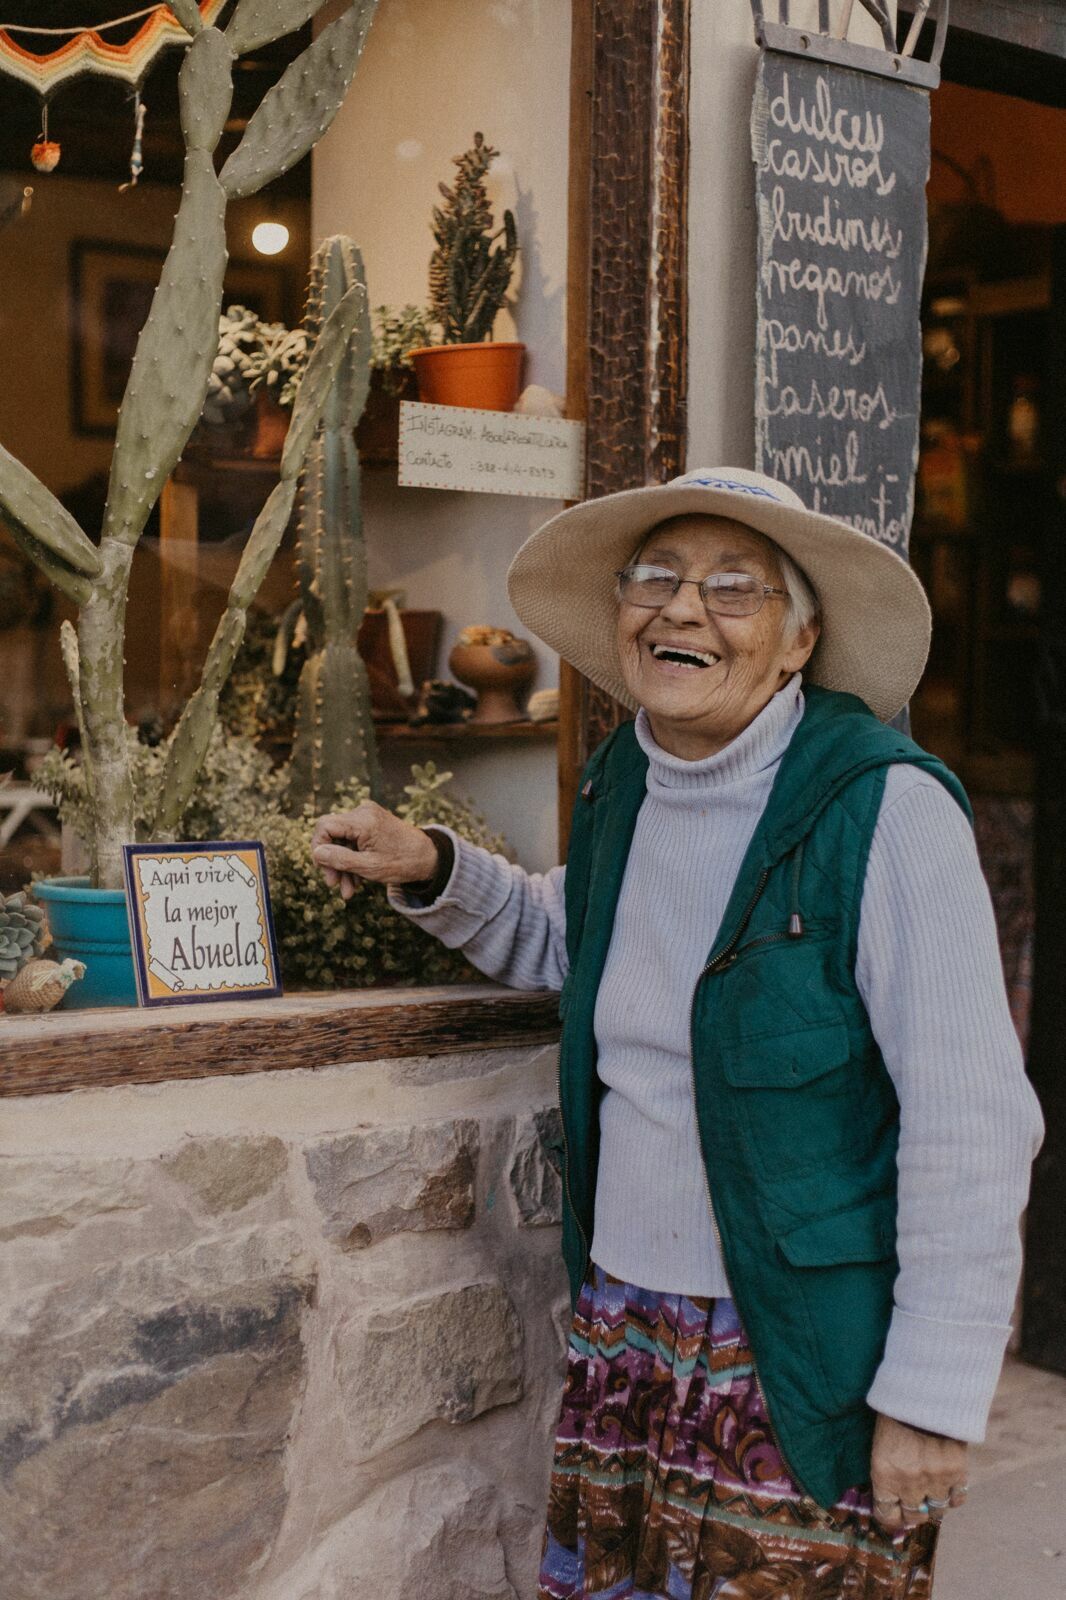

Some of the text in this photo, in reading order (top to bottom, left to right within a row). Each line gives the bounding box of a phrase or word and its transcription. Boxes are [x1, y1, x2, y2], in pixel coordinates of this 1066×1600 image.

[770, 71, 885, 152] dulces
[772, 186, 903, 259] budines
[766, 319, 866, 388] panes
[772, 430, 867, 487] miel
[150, 866, 235, 891] Aqui vive
[165, 897, 238, 927] la mejor
[170, 922, 258, 971] Abuela
